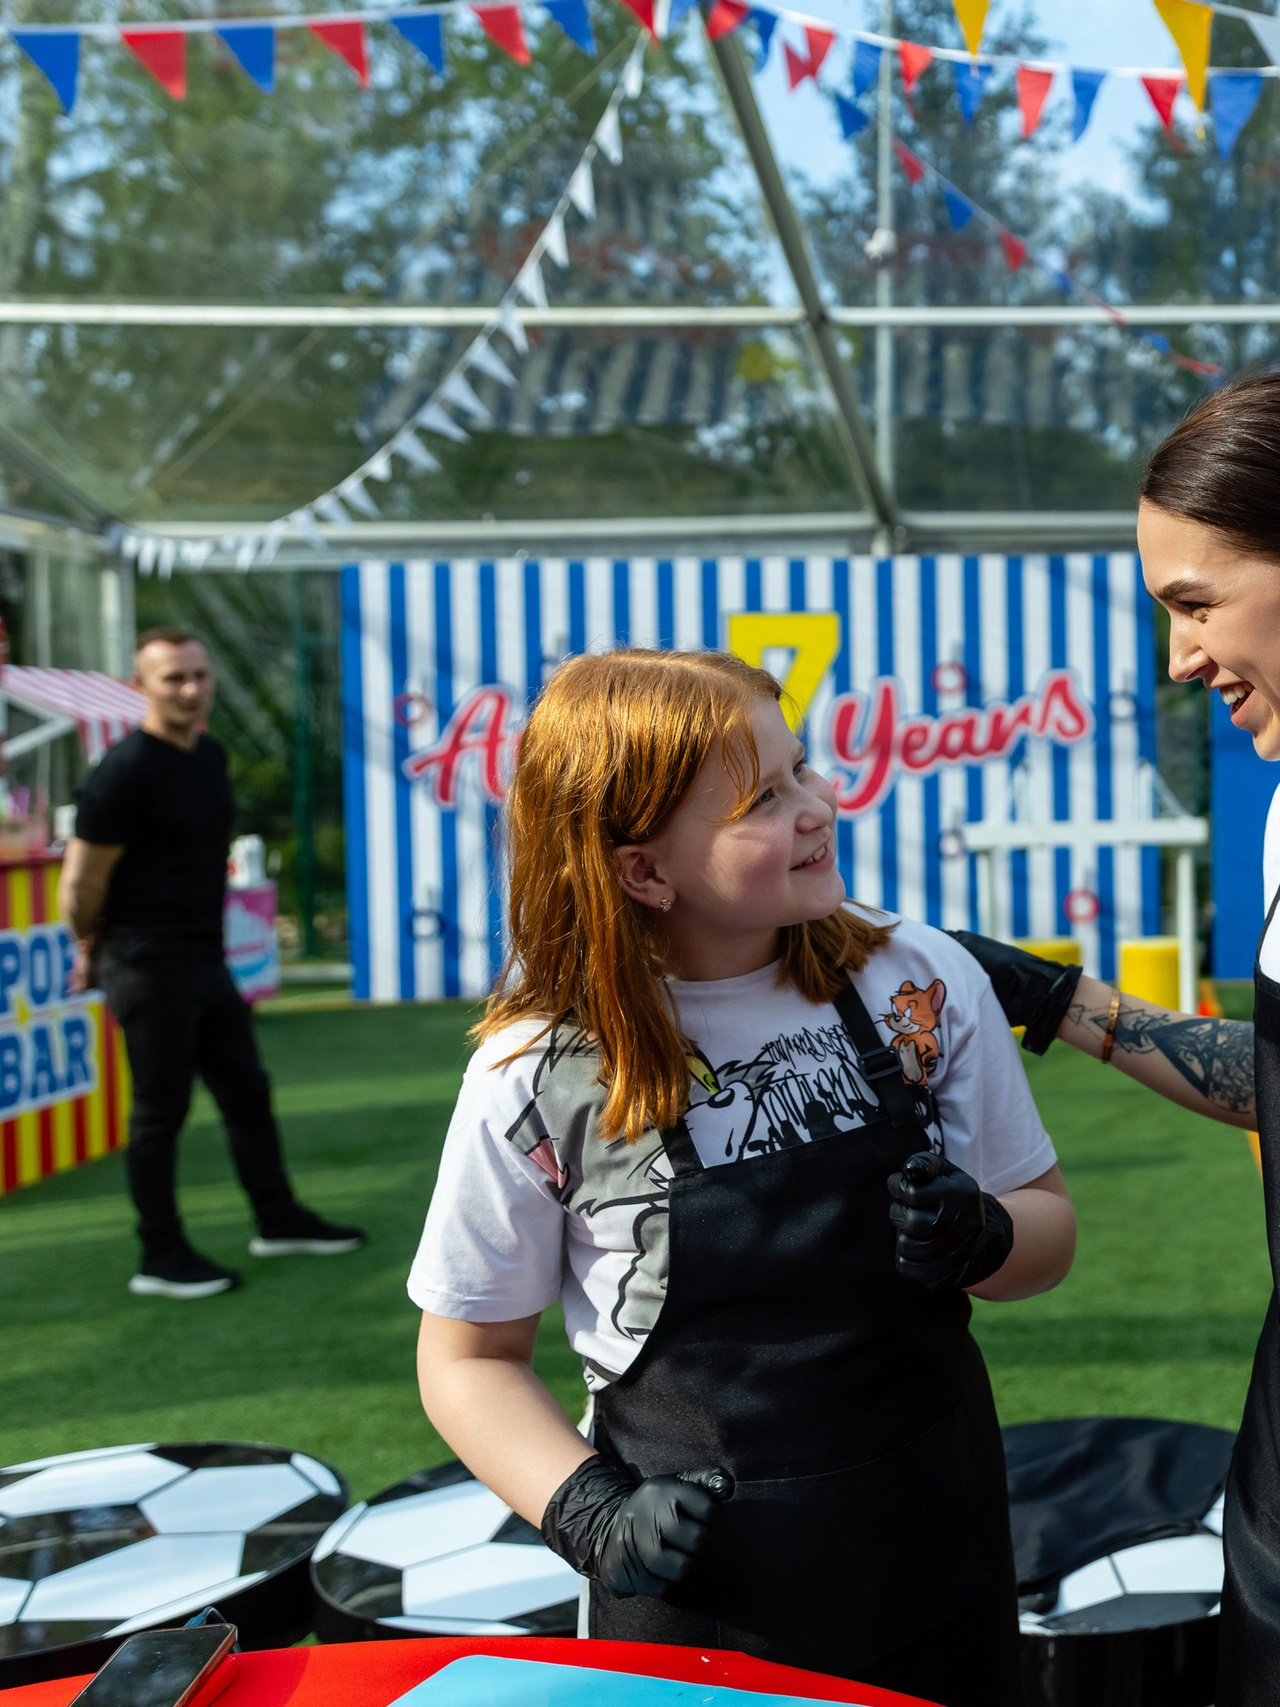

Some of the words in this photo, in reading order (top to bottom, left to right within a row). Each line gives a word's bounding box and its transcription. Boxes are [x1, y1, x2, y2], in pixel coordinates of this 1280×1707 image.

[729, 612, 841, 735] 7
[828, 673, 1090, 814] Years
[0, 1017, 91, 1110] BAR
